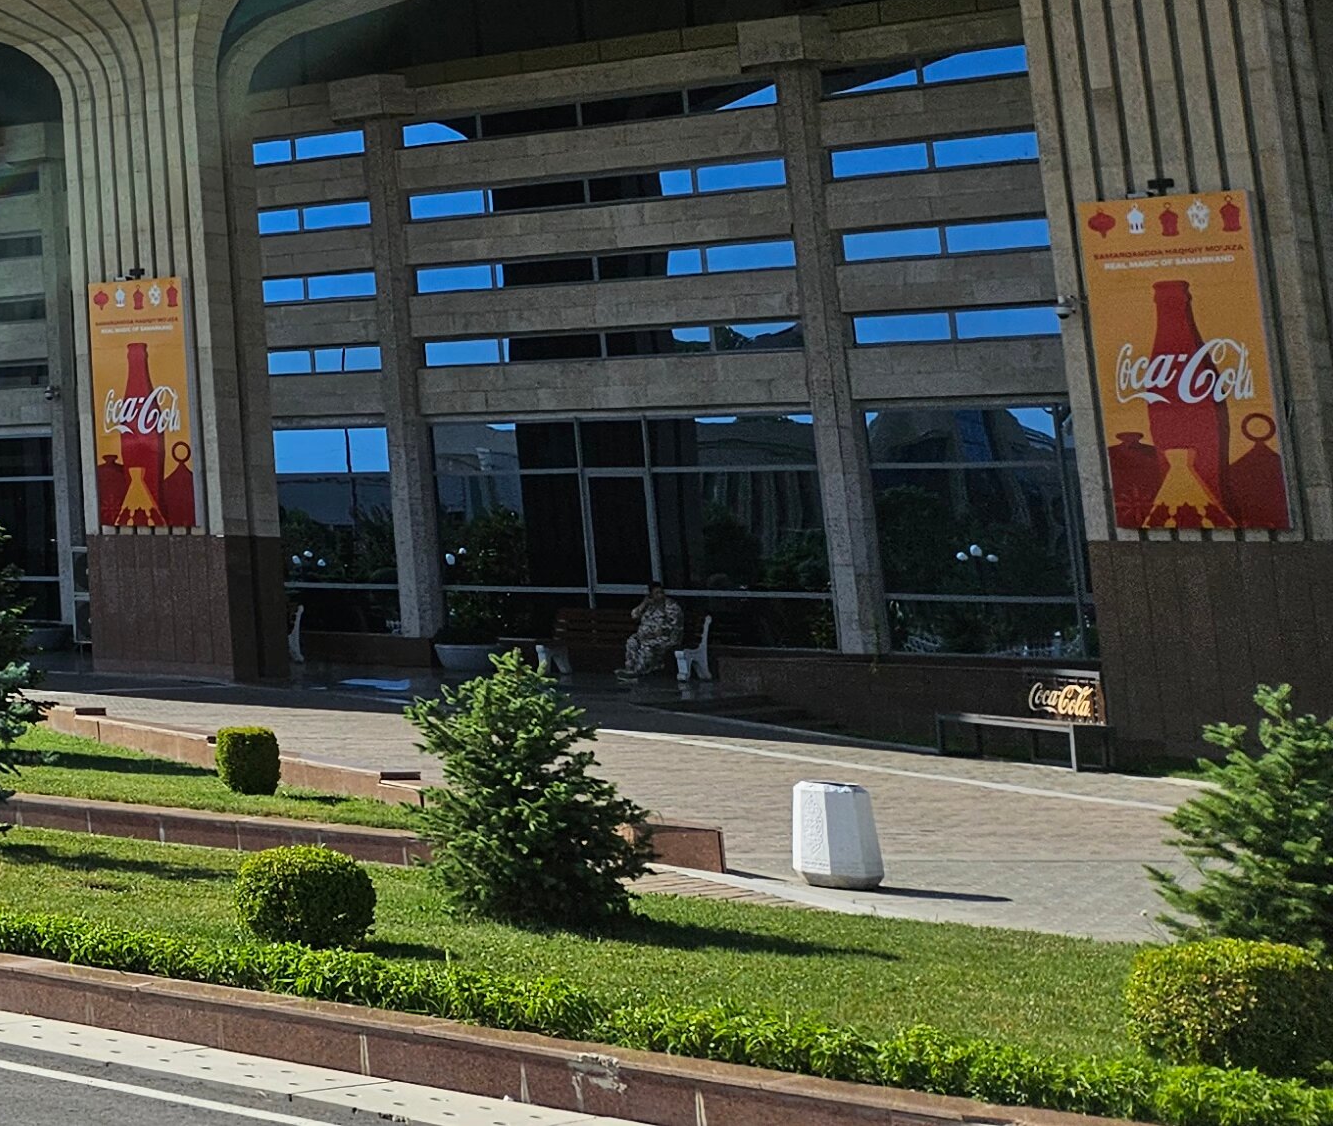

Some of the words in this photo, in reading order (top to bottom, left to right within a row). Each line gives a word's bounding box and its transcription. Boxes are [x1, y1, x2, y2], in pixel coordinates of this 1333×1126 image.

[1104, 261, 1128, 271] REAL
[1129, 259, 1159, 268] MAGIC
[1160, 257, 1174, 266] OF
[1175, 254, 1235, 265] SAMARKAND
[1116, 338, 1254, 404] Coca-Cola
[104, 386, 181, 434] Coca-Cola
[1028, 682, 1094, 717] Coca-Cola
